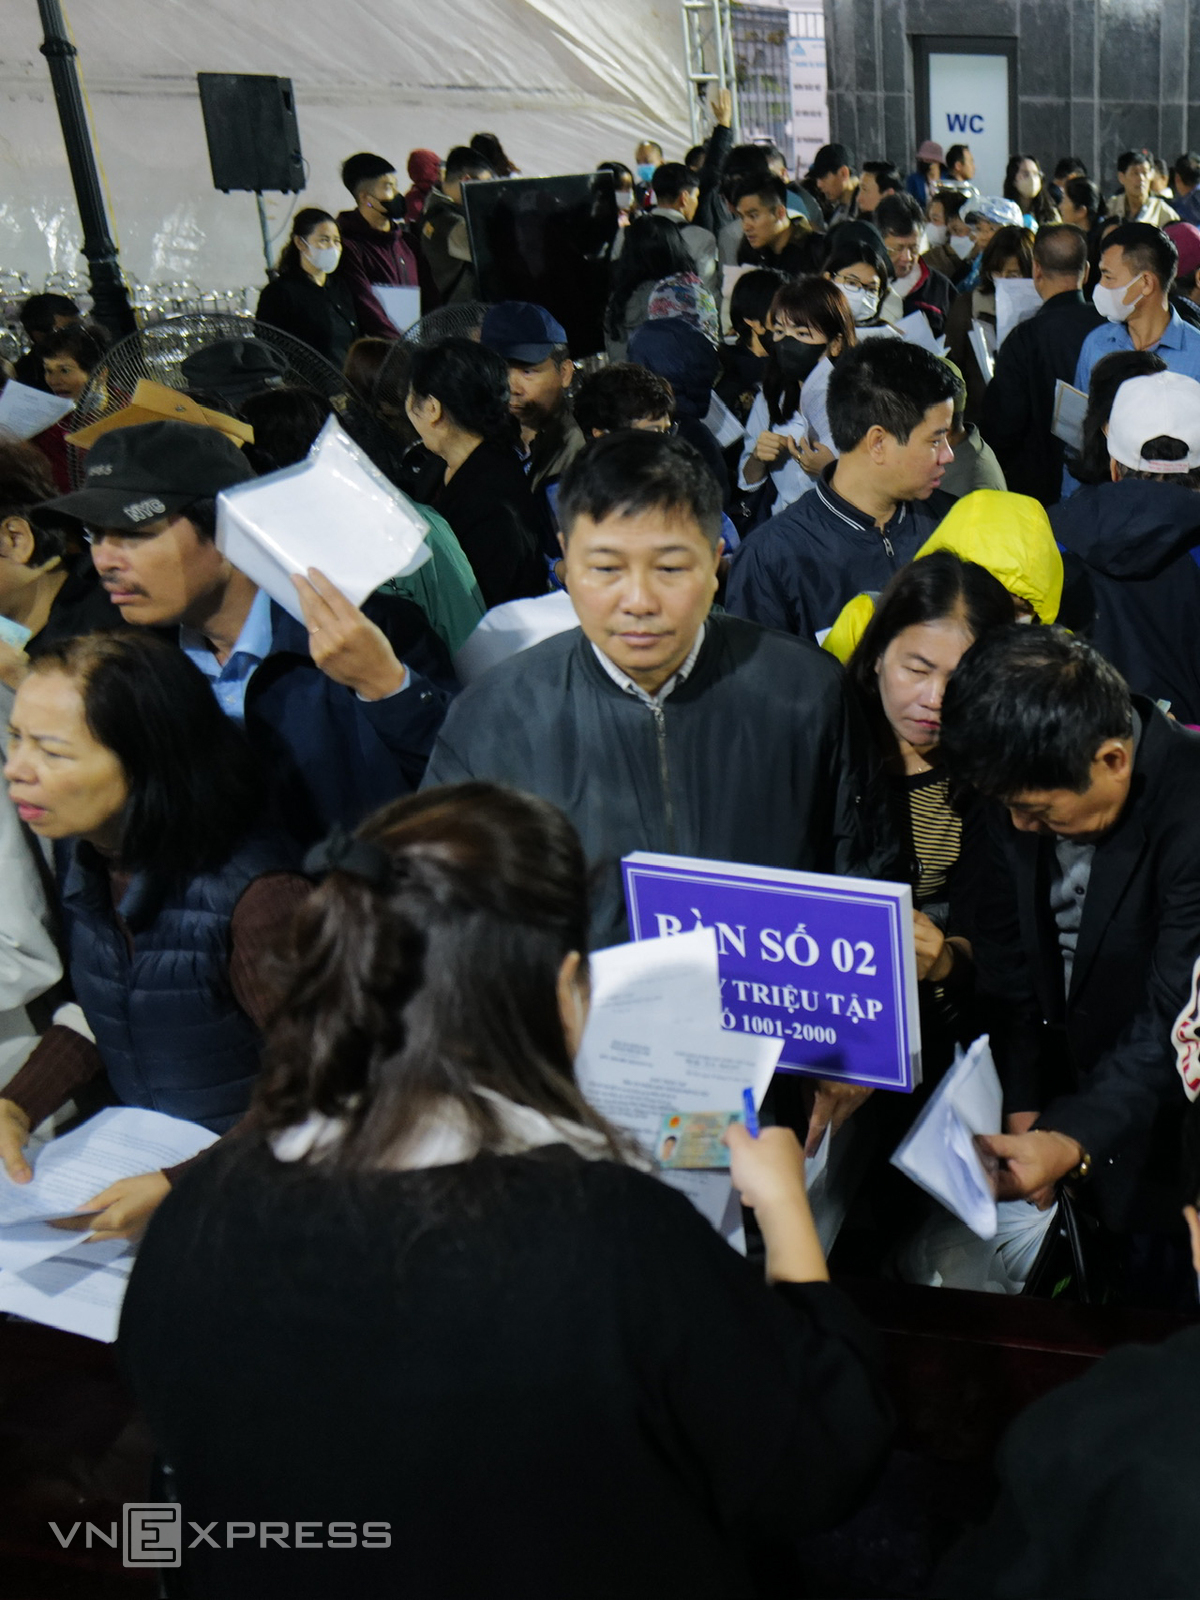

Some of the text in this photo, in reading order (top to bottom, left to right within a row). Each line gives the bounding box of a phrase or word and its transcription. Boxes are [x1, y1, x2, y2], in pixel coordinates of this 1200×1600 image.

[946, 113, 984, 133] WC
[759, 922, 821, 967] SỐ
[831, 937, 878, 977] 02
[731, 979, 819, 1014] TRIỆU
[825, 992, 884, 1024] TẬP
[719, 1006, 838, 1045] Ố 1001-2000
